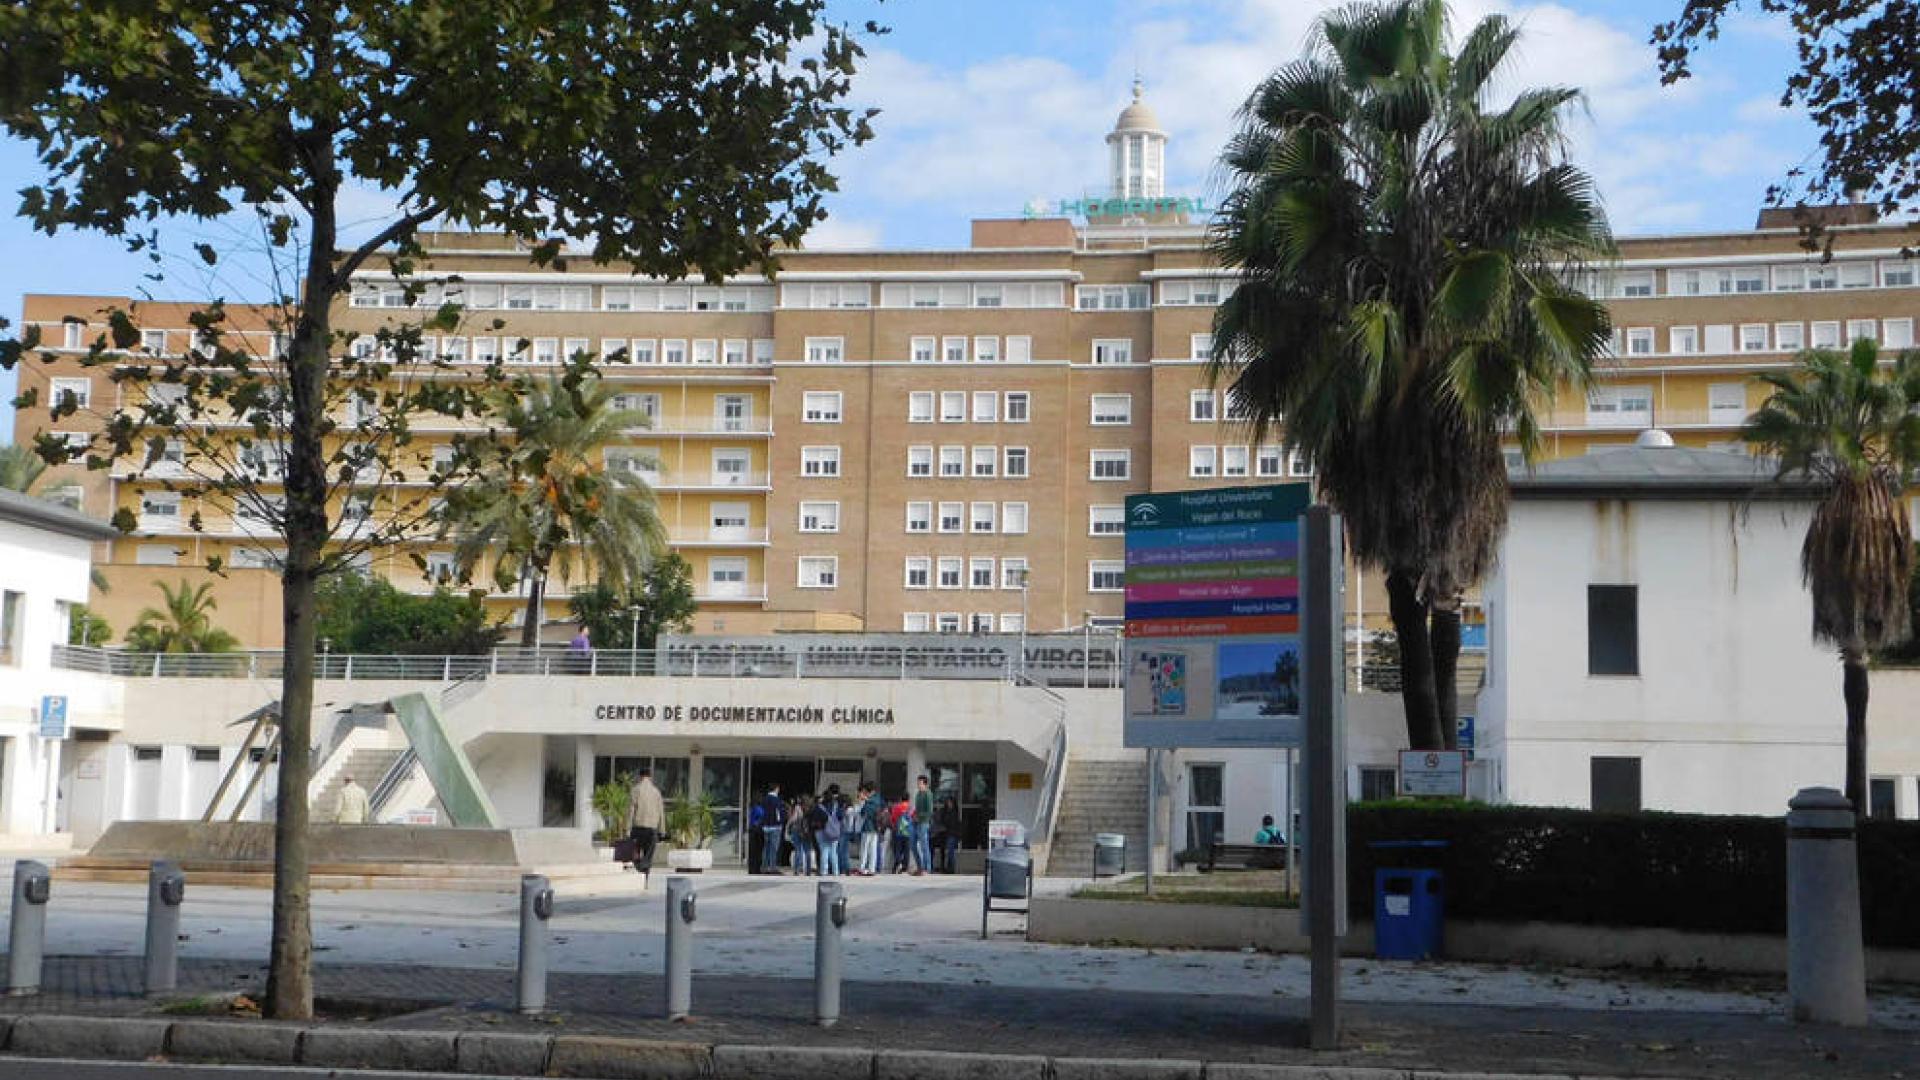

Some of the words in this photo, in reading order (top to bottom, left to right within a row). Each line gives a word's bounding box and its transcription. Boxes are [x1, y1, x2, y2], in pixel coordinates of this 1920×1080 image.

[1061, 197, 1213, 217] HOSPITAL
[1181, 495, 1216, 506] Hospital
[1219, 490, 1273, 504] Universitario
[1191, 512, 1218, 523] Virgen
[1220, 510, 1235, 520] del
[1232, 603, 1264, 615] Hospital
[668, 644, 793, 666] HOSPITAL
[807, 645, 1005, 668] UNIVERSITARIO
[1023, 647, 1123, 669] VIRGEN
[595, 705, 656, 720] CENTRO
[663, 706, 683, 722] DE
[690, 704, 823, 723] DOCUMENTACIÓN
[832, 705, 895, 724] CLÍNICA
